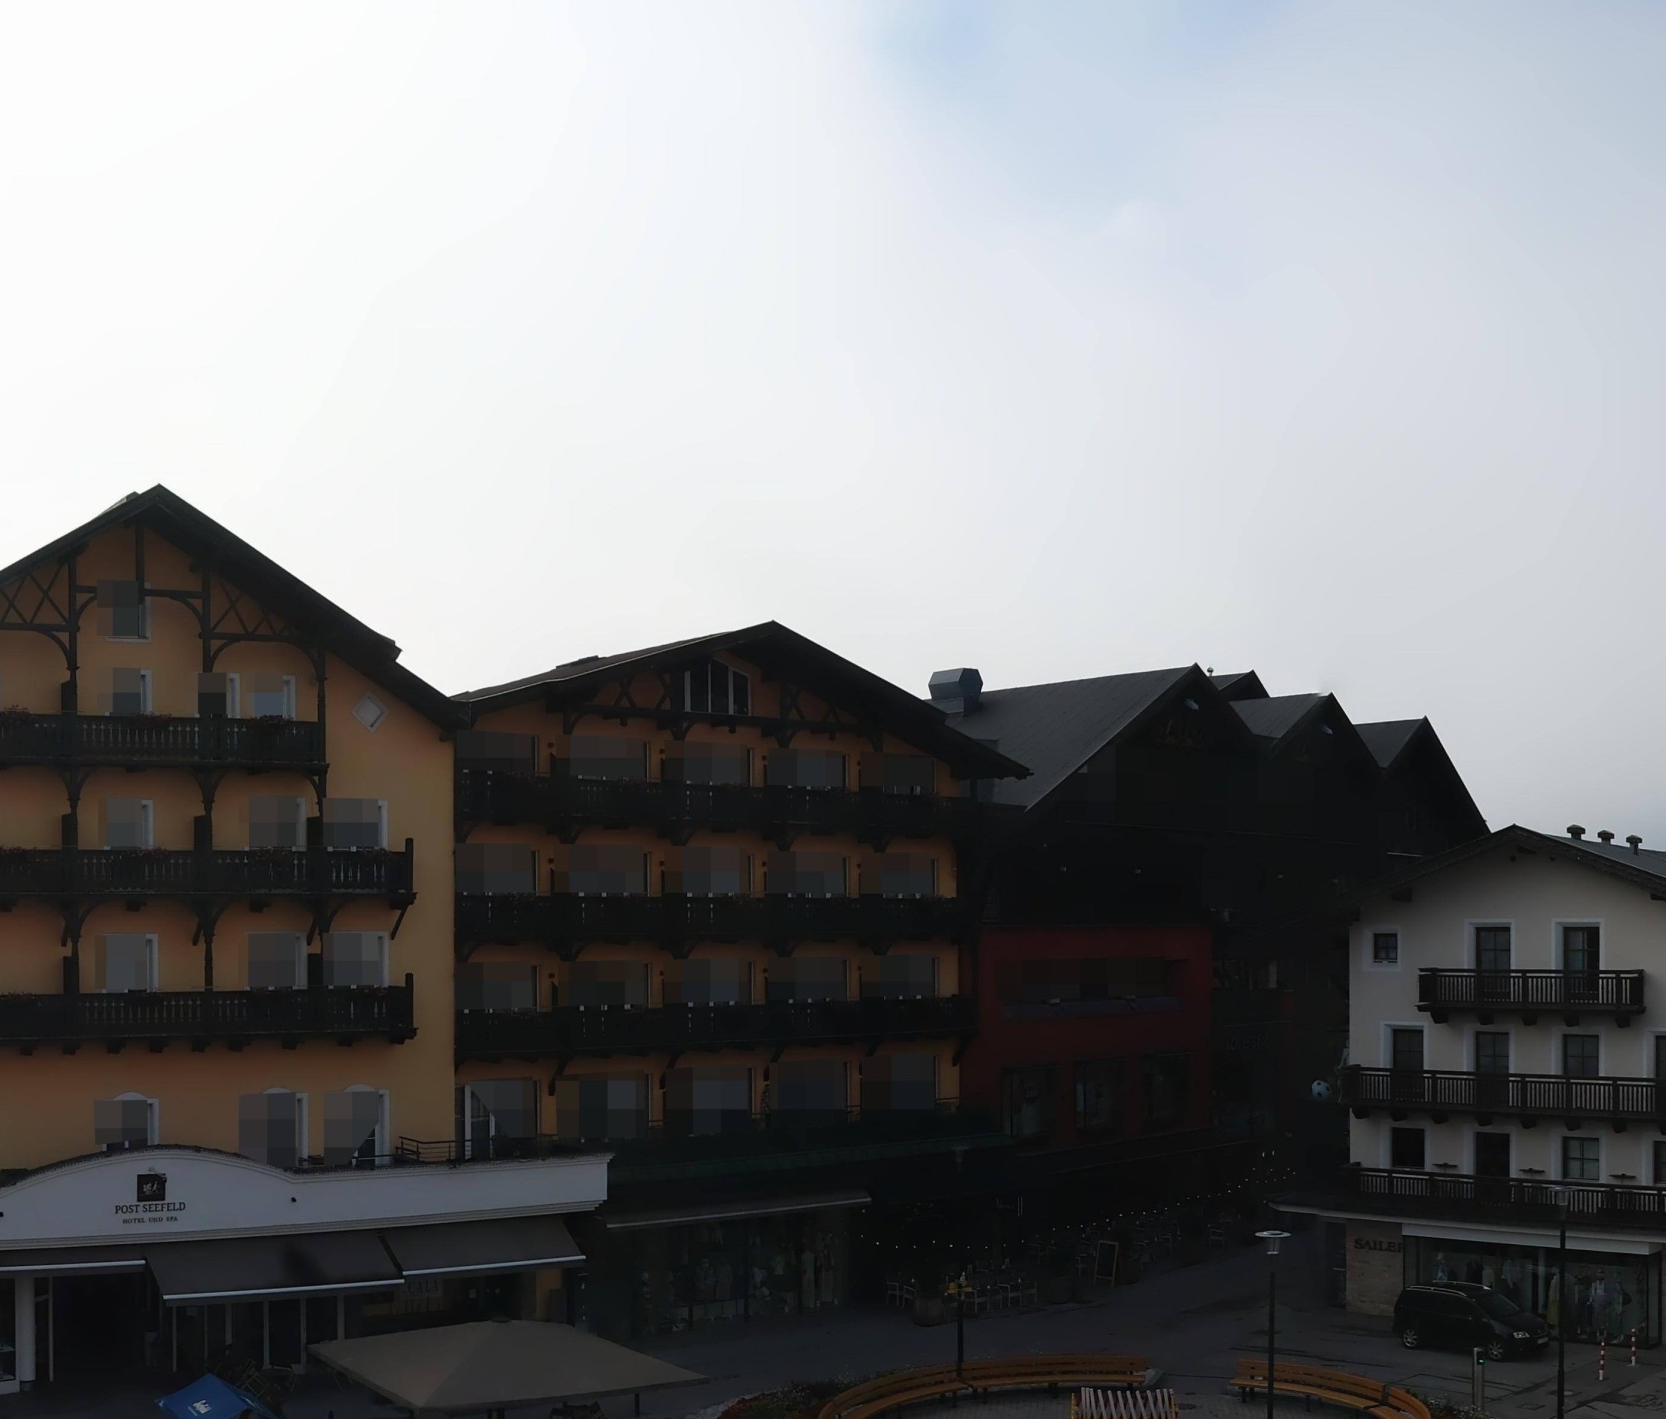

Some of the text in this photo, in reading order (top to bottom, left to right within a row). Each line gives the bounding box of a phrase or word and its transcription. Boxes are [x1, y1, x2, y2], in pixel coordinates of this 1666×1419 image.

[115, 1202, 186, 1214] POST SEEFELD
[122, 1217, 146, 1225] HOTEL
